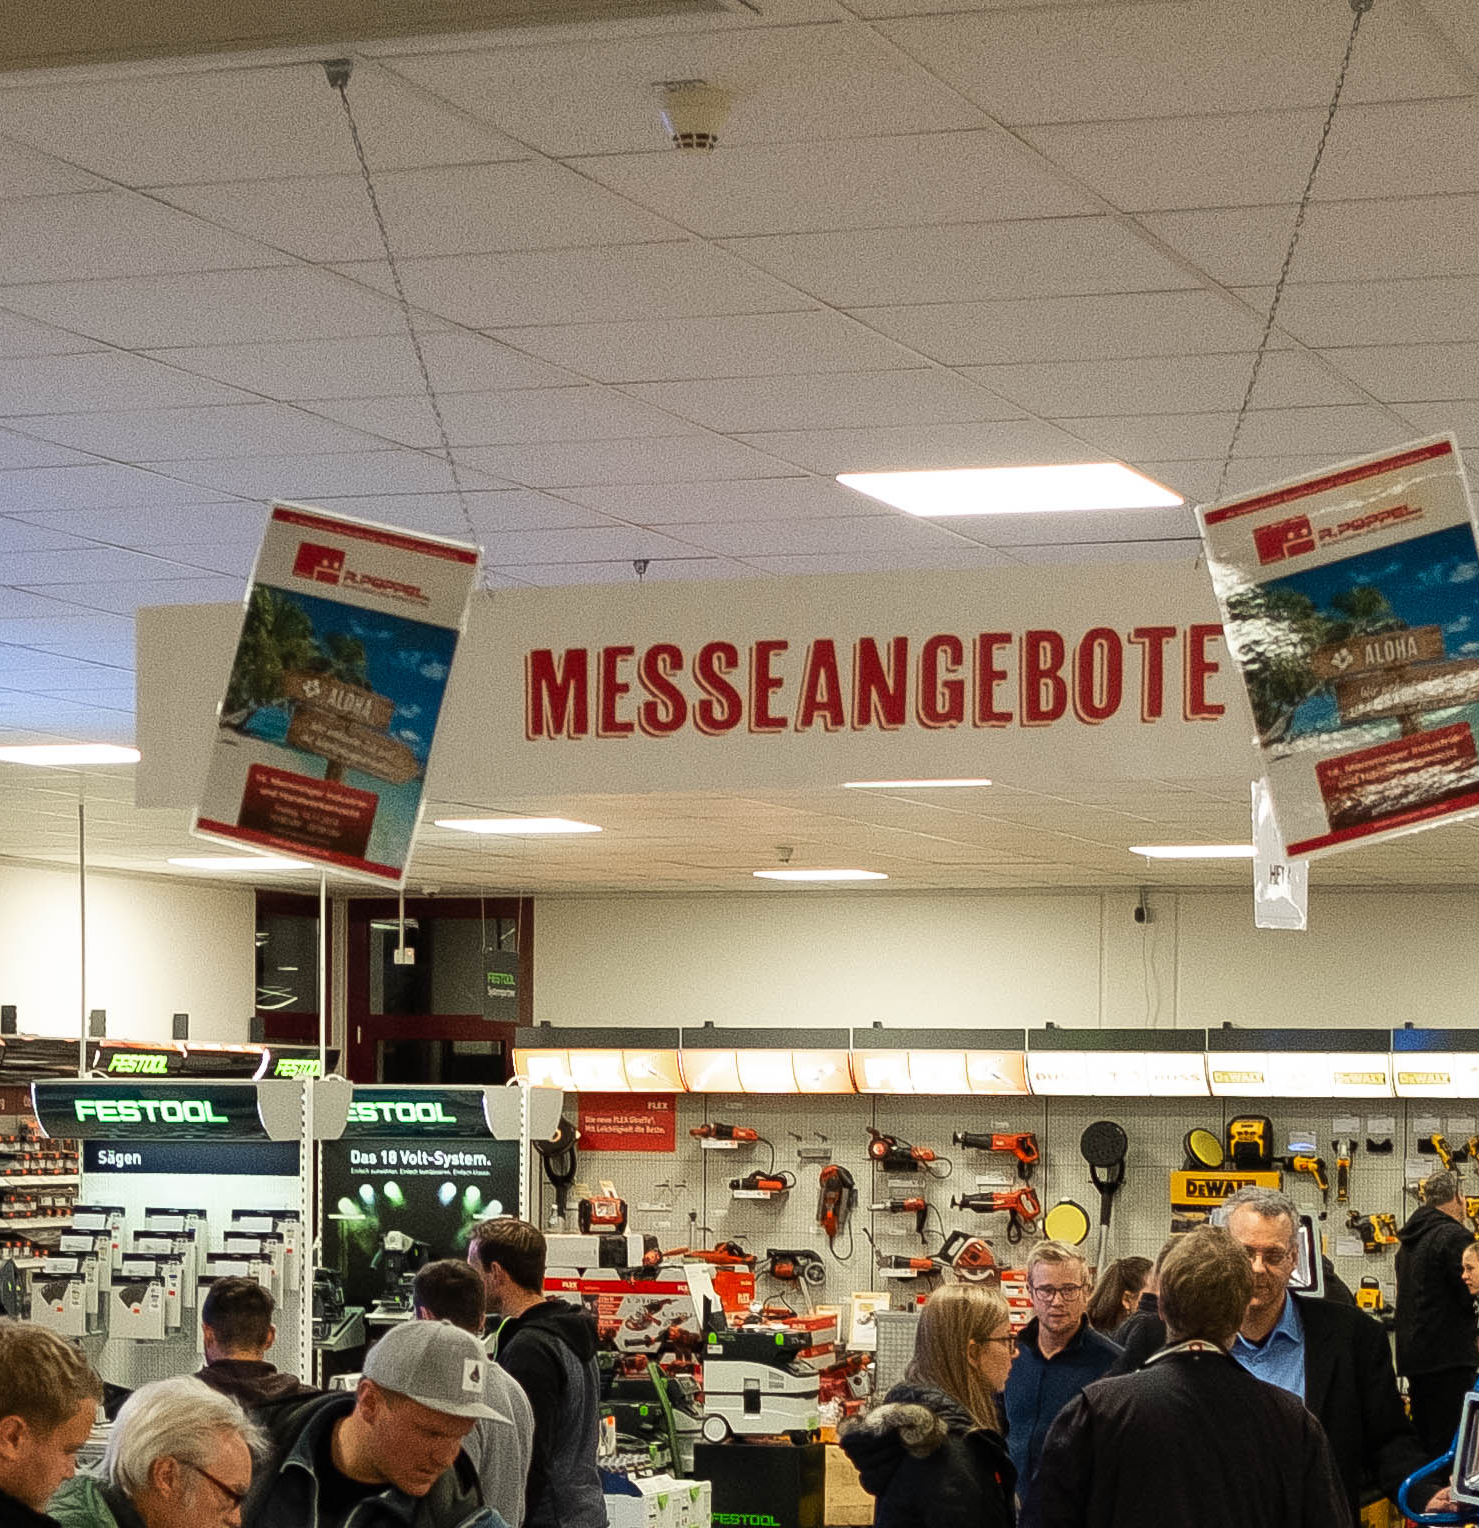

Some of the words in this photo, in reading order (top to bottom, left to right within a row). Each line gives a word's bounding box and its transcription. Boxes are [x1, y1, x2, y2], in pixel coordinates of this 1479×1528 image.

[1364, 635, 1418, 665] ALOHA
[525, 622, 1226, 741] MESSEANGEBOTE
[331, 687, 373, 718] ALOHA
[108, 1054, 168, 1074] FESTOOL
[74, 1099, 229, 1124] FESTOOL
[346, 1101, 457, 1123] ESTOOL
[647, 1101, 668, 1110] FLEX
[98, 1148, 142, 1167] Sägen
[350, 1150, 377, 1166] Das
[380, 1150, 397, 1166] 18
[400, 1150, 491, 1168] Volt-System.
[711, 1512, 781, 1527] FESTOOL
